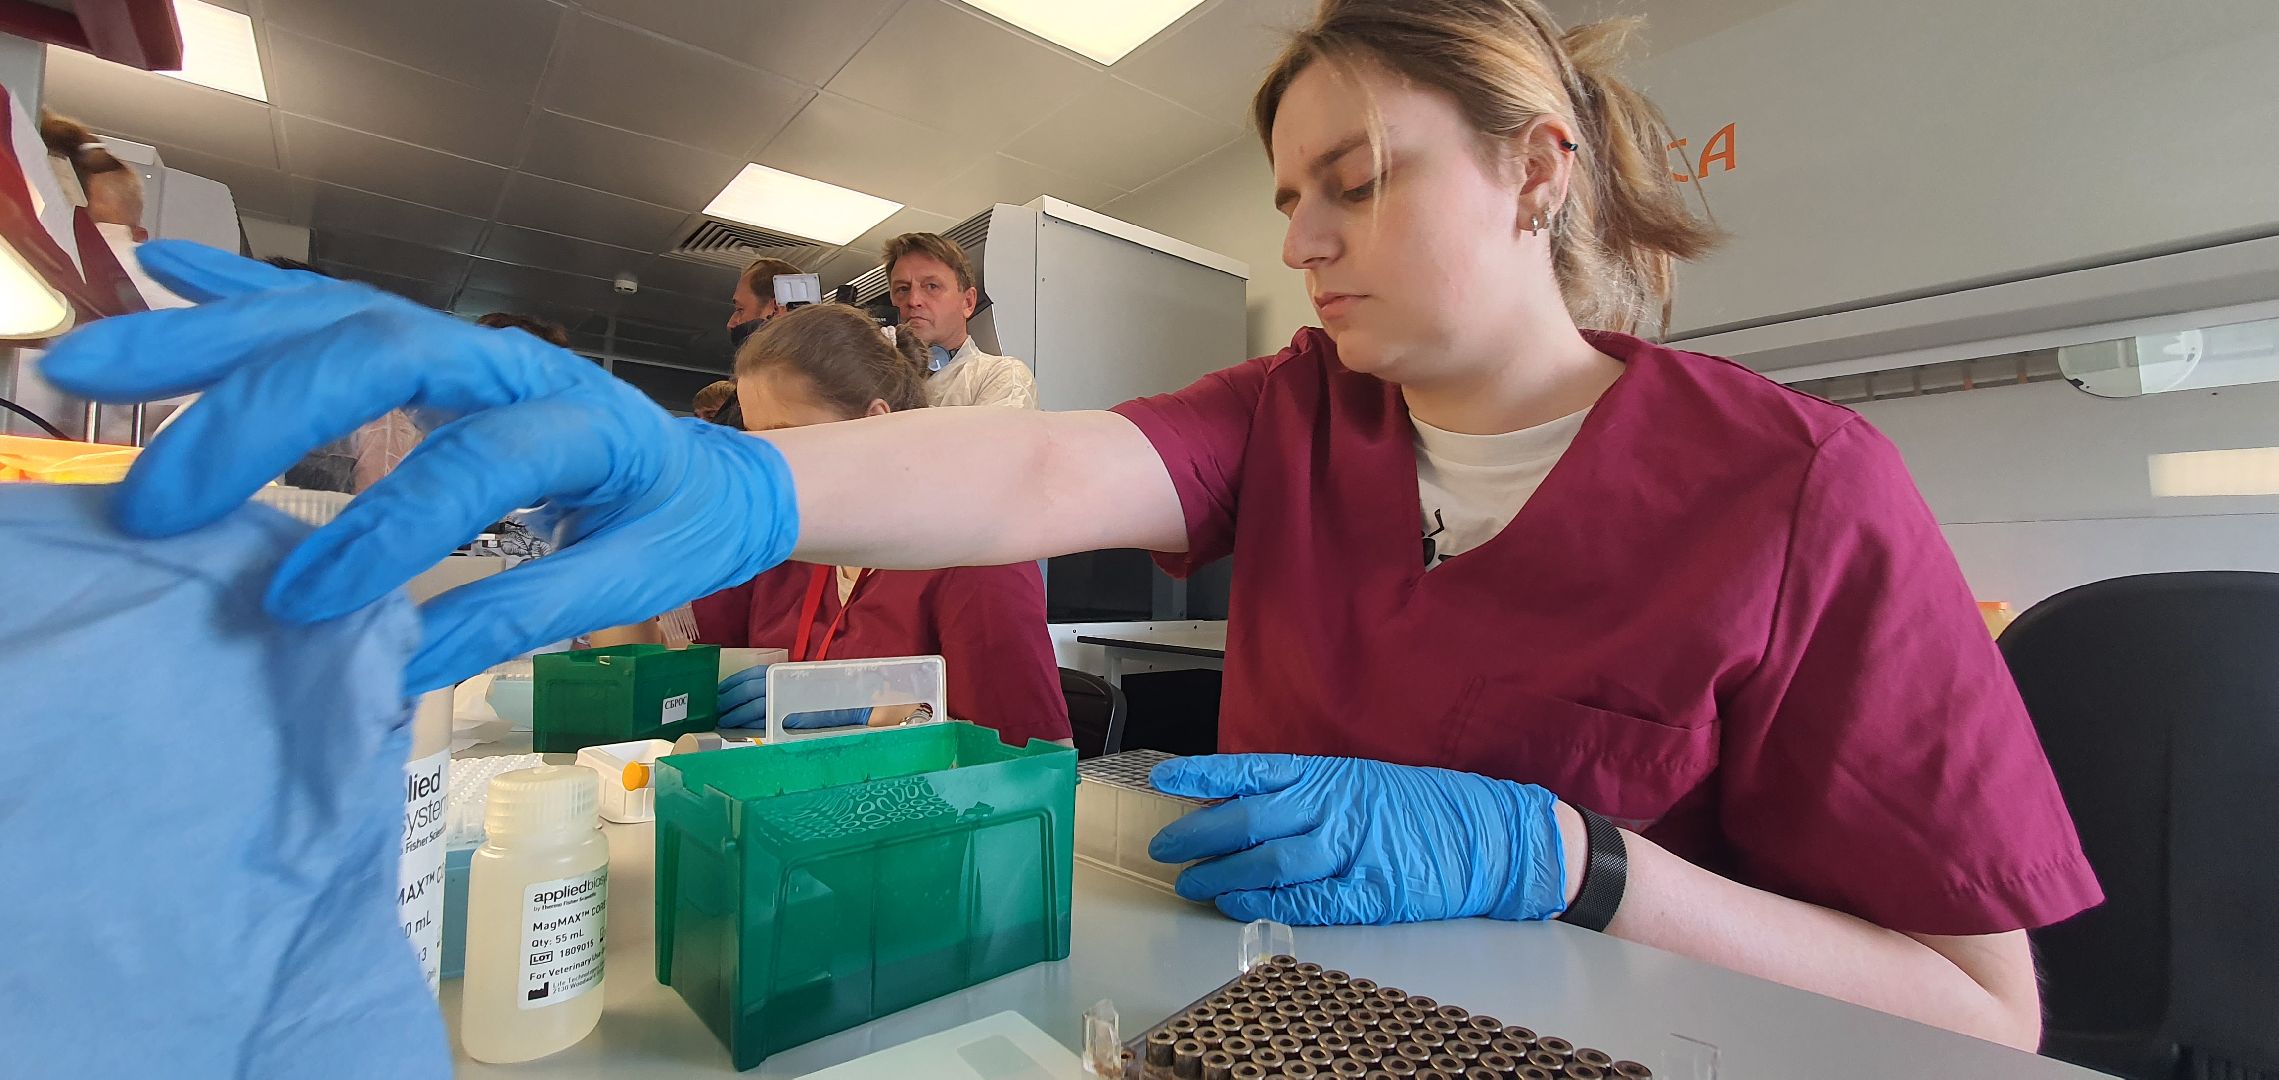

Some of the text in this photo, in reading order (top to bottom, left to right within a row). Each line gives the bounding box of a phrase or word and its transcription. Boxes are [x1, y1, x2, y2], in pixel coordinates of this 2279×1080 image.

[1665, 122, 1736, 183] CA
[665, 696, 687, 709] СБРОС
[406, 764, 441, 803] lied
[405, 836, 429, 854] Fisher
[415, 910, 432, 933] mL
[531, 939, 552, 948] Qty:
[555, 932, 568, 944] 55
[570, 928, 585, 940] mL
[532, 953, 552, 963] LOT
[560, 938, 594, 958] 1809015
[530, 972, 547, 981] For
[548, 957, 592, 977] Veterinary
